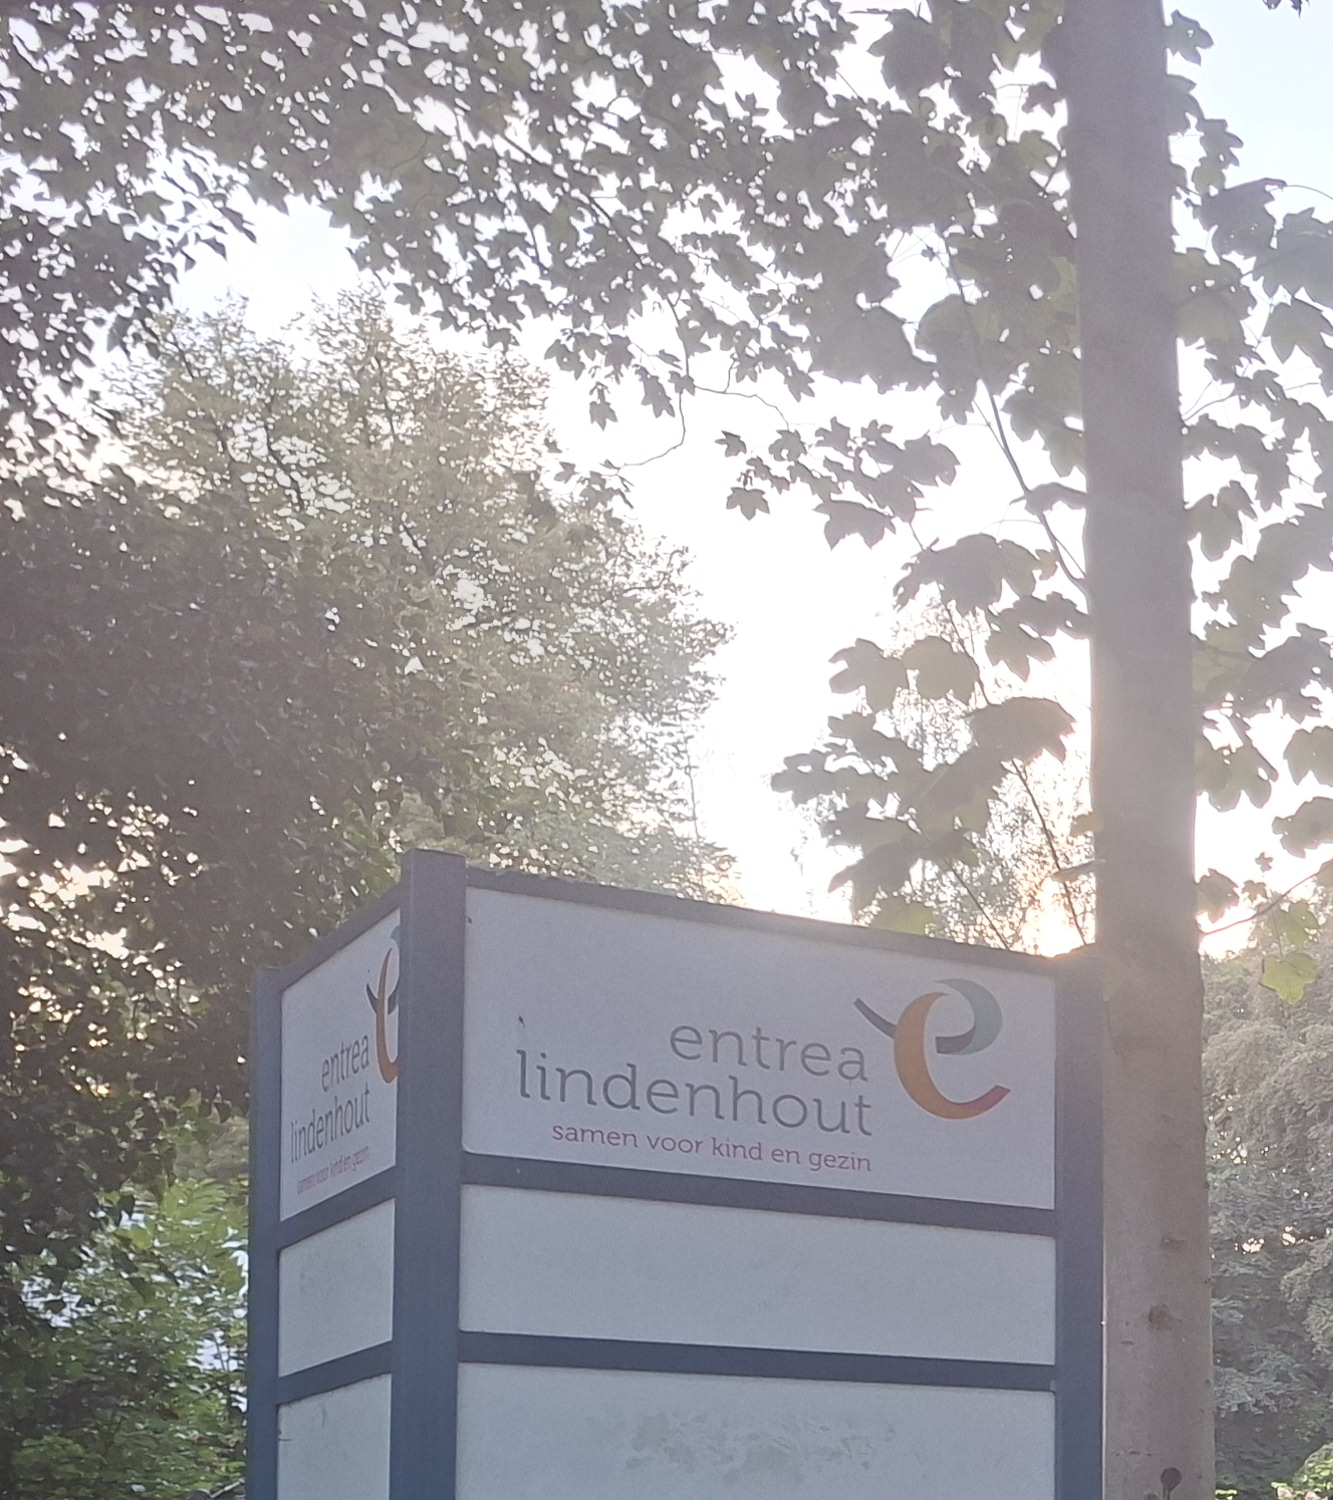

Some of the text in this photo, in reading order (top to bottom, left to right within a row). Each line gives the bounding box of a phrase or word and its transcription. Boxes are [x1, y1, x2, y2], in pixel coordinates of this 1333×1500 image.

[321, 1034, 370, 1093] entrea
[669, 1024, 870, 1083] entrea
[515, 1048, 873, 1137] lindenhout
[290, 1082, 371, 1164] lindenhout
[551, 1124, 872, 1173] samen voor kind en gezin
